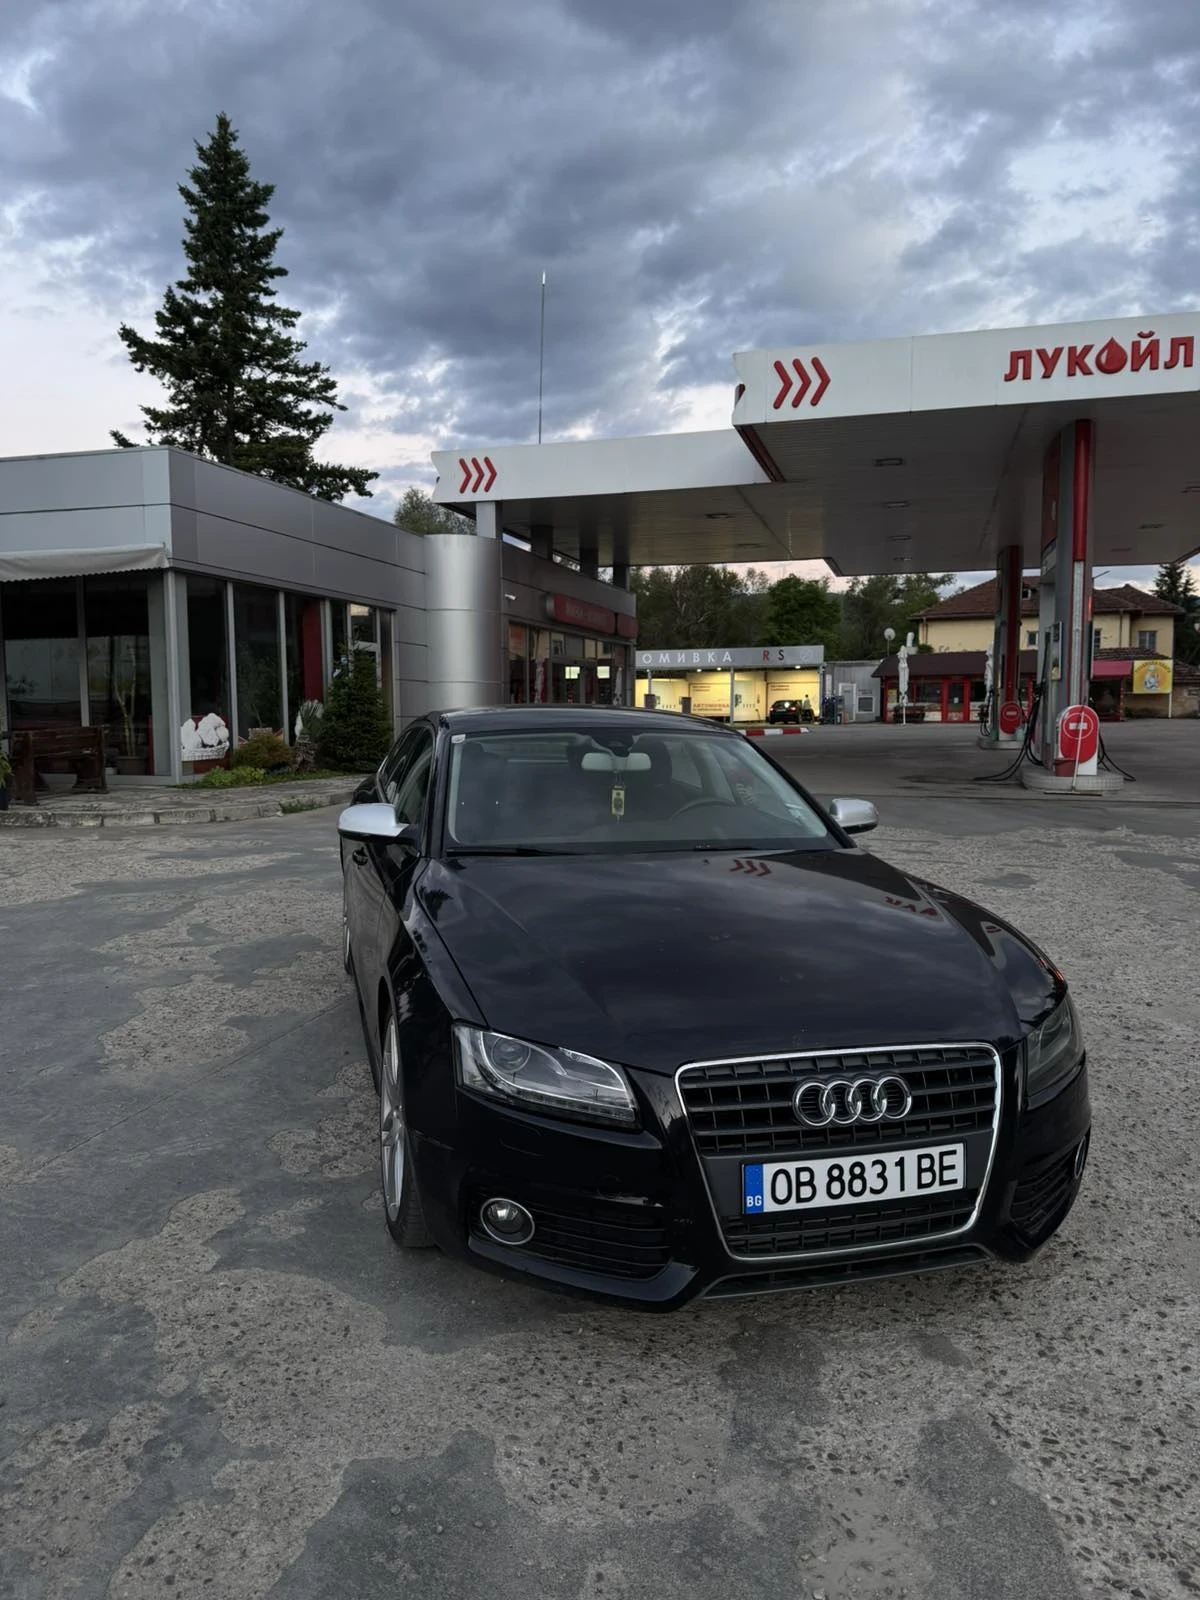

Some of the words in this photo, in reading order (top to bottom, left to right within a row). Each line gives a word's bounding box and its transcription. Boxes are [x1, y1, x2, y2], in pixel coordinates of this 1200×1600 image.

[770, 1166, 817, 1205] OB
[826, 1156, 905, 1200] 8831
[917, 1149, 958, 1189] BE
[746, 1194, 762, 1208] BG
